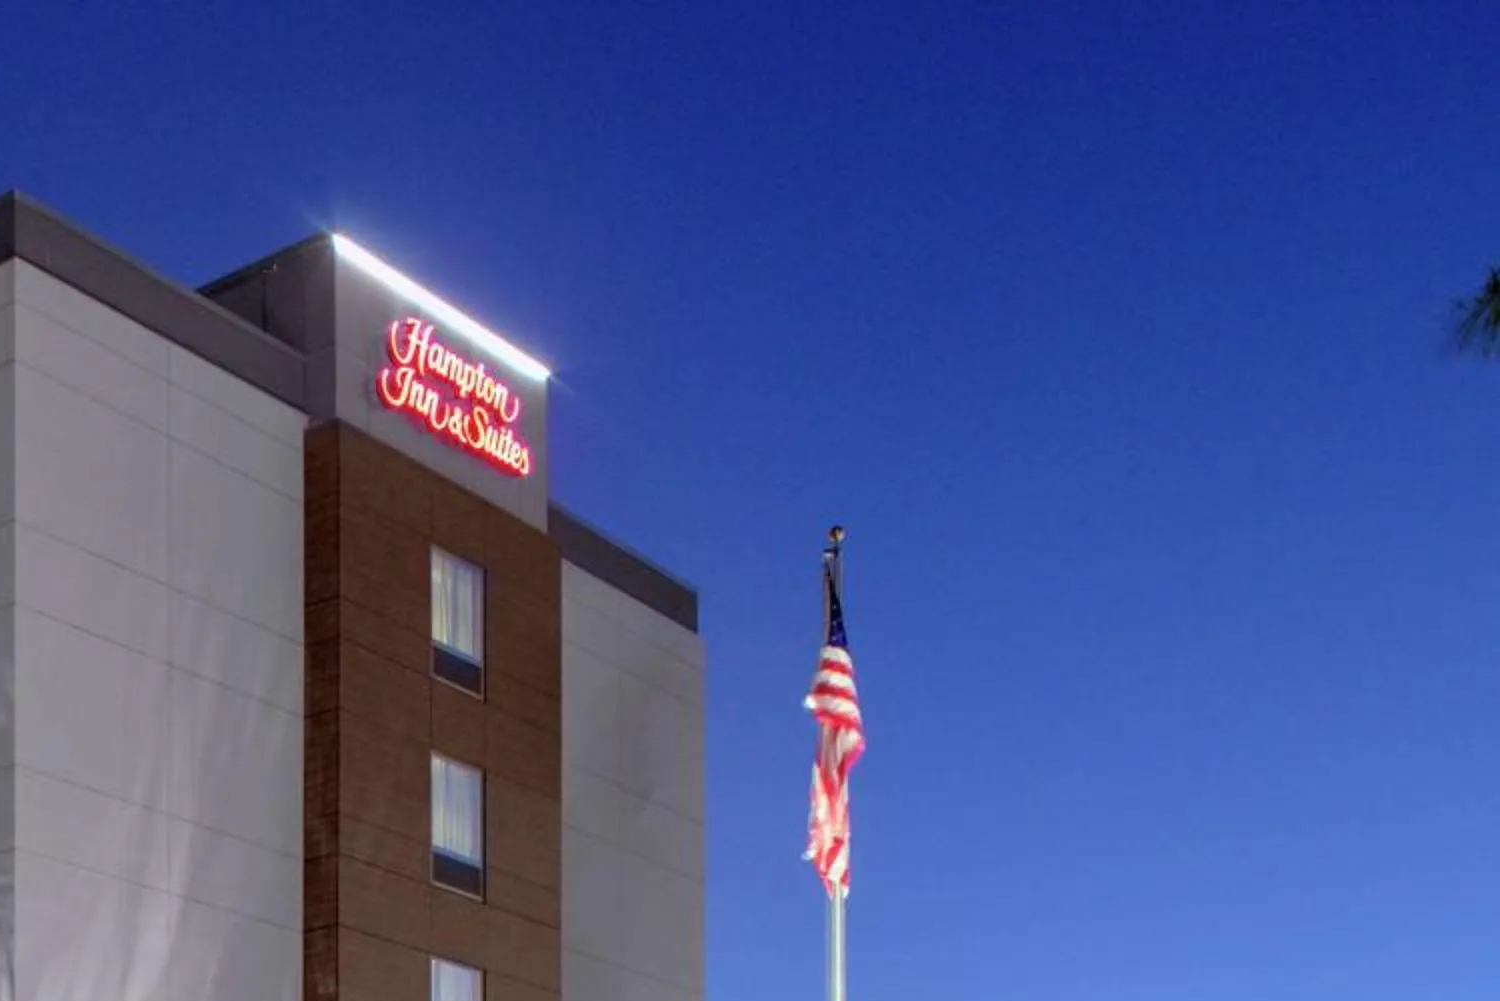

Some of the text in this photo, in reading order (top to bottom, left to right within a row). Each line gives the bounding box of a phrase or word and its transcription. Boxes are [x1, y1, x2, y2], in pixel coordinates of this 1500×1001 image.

[379, 366, 531, 477] Inn & Suites
[388, 316, 521, 424] Hampton
